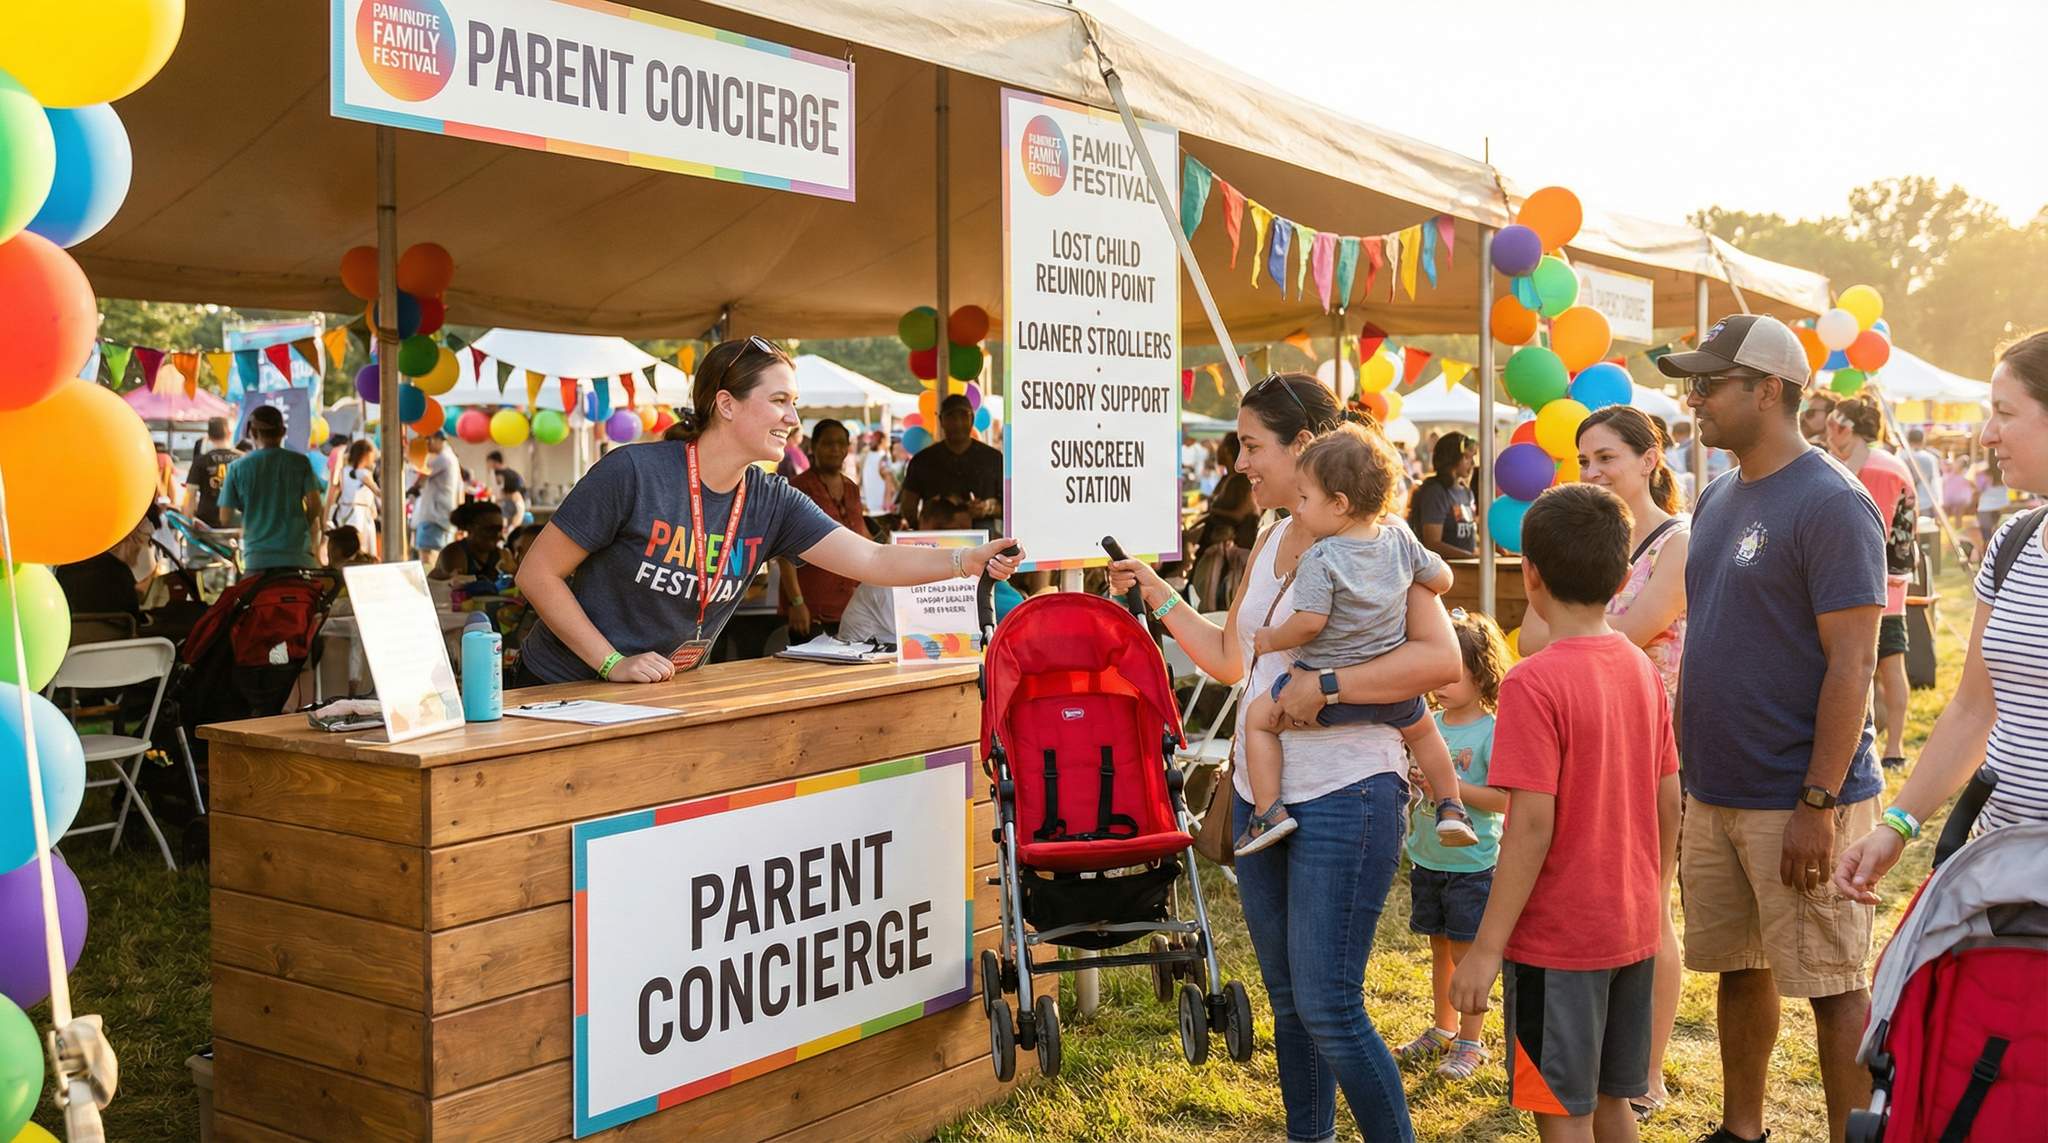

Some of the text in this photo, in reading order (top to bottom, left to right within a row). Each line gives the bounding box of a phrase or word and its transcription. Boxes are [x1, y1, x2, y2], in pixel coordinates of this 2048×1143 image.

[372, 21, 440, 55] FAMILY
[372, 46, 440, 76] FESTIVAL
[467, 20, 840, 156] PARENT CONCIERGE
[1028, 145, 1062, 166] FAMILY
[1072, 134, 1137, 171] FAMILY
[1072, 165, 1156, 205] FESTIVAL
[1052, 229, 1141, 268] LOST CHILD
[1036, 263, 1156, 304] REUNION POINT
[1018, 321, 1172, 360] LOANER STROLLERS
[1021, 380, 1170, 413] SENSORY SUPPORT
[1050, 440, 1145, 469] SUNSCREEN
[1065, 476, 1131, 504] STATION
[634, 560, 742, 602] FESTVAL
[690, 829, 893, 952] PARENT
[638, 899, 932, 1057] CONCIERGE
